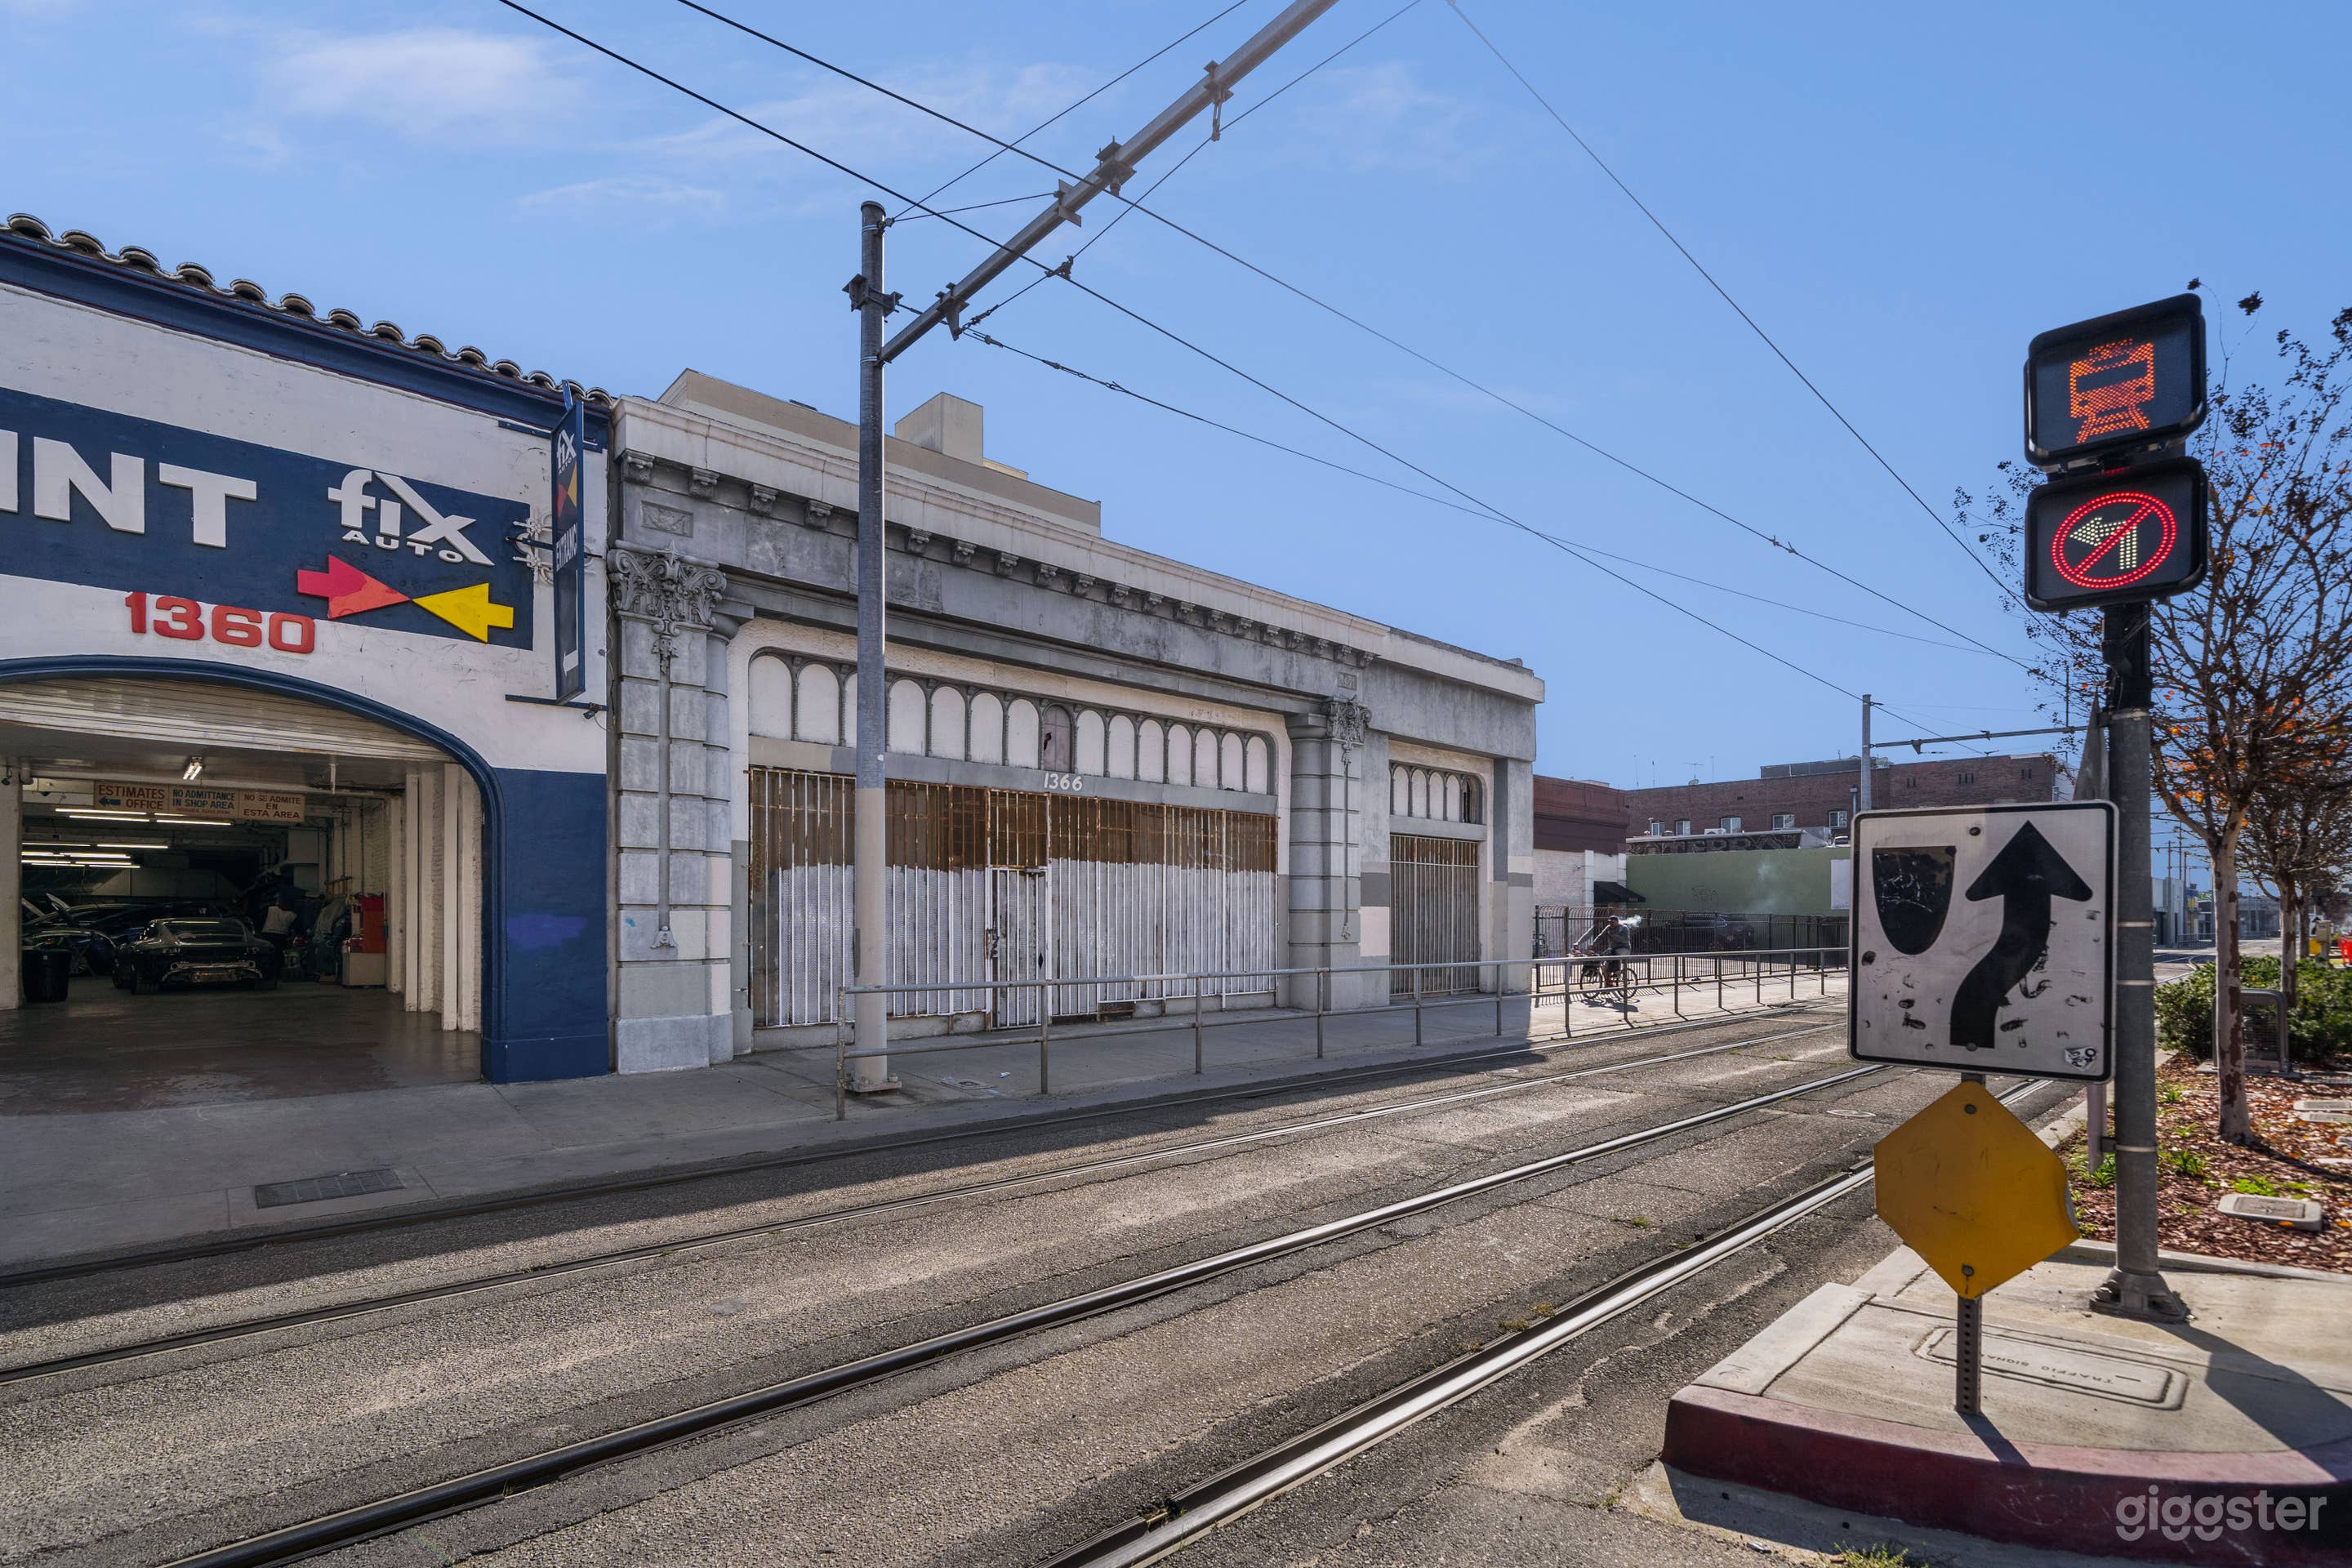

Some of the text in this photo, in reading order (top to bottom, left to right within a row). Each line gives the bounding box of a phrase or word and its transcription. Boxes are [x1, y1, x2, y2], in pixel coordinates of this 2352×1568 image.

[558, 457, 572, 475] AUTO
[341, 530, 463, 564] AUTO
[555, 522, 577, 572] ENTRANC
[125, 591, 315, 653] 1360
[1044, 773, 1083, 791] 1366
[98, 785, 165, 800] ESTIMATES
[172, 789, 236, 801] NO ADMITTANCE
[244, 794, 255, 802] NO
[270, 795, 301, 804] ADMITE
[126, 799, 164, 810] OFFICE
[172, 798, 234, 809] IN SHOP AREA
[243, 808, 301, 819] ESTA AREA
